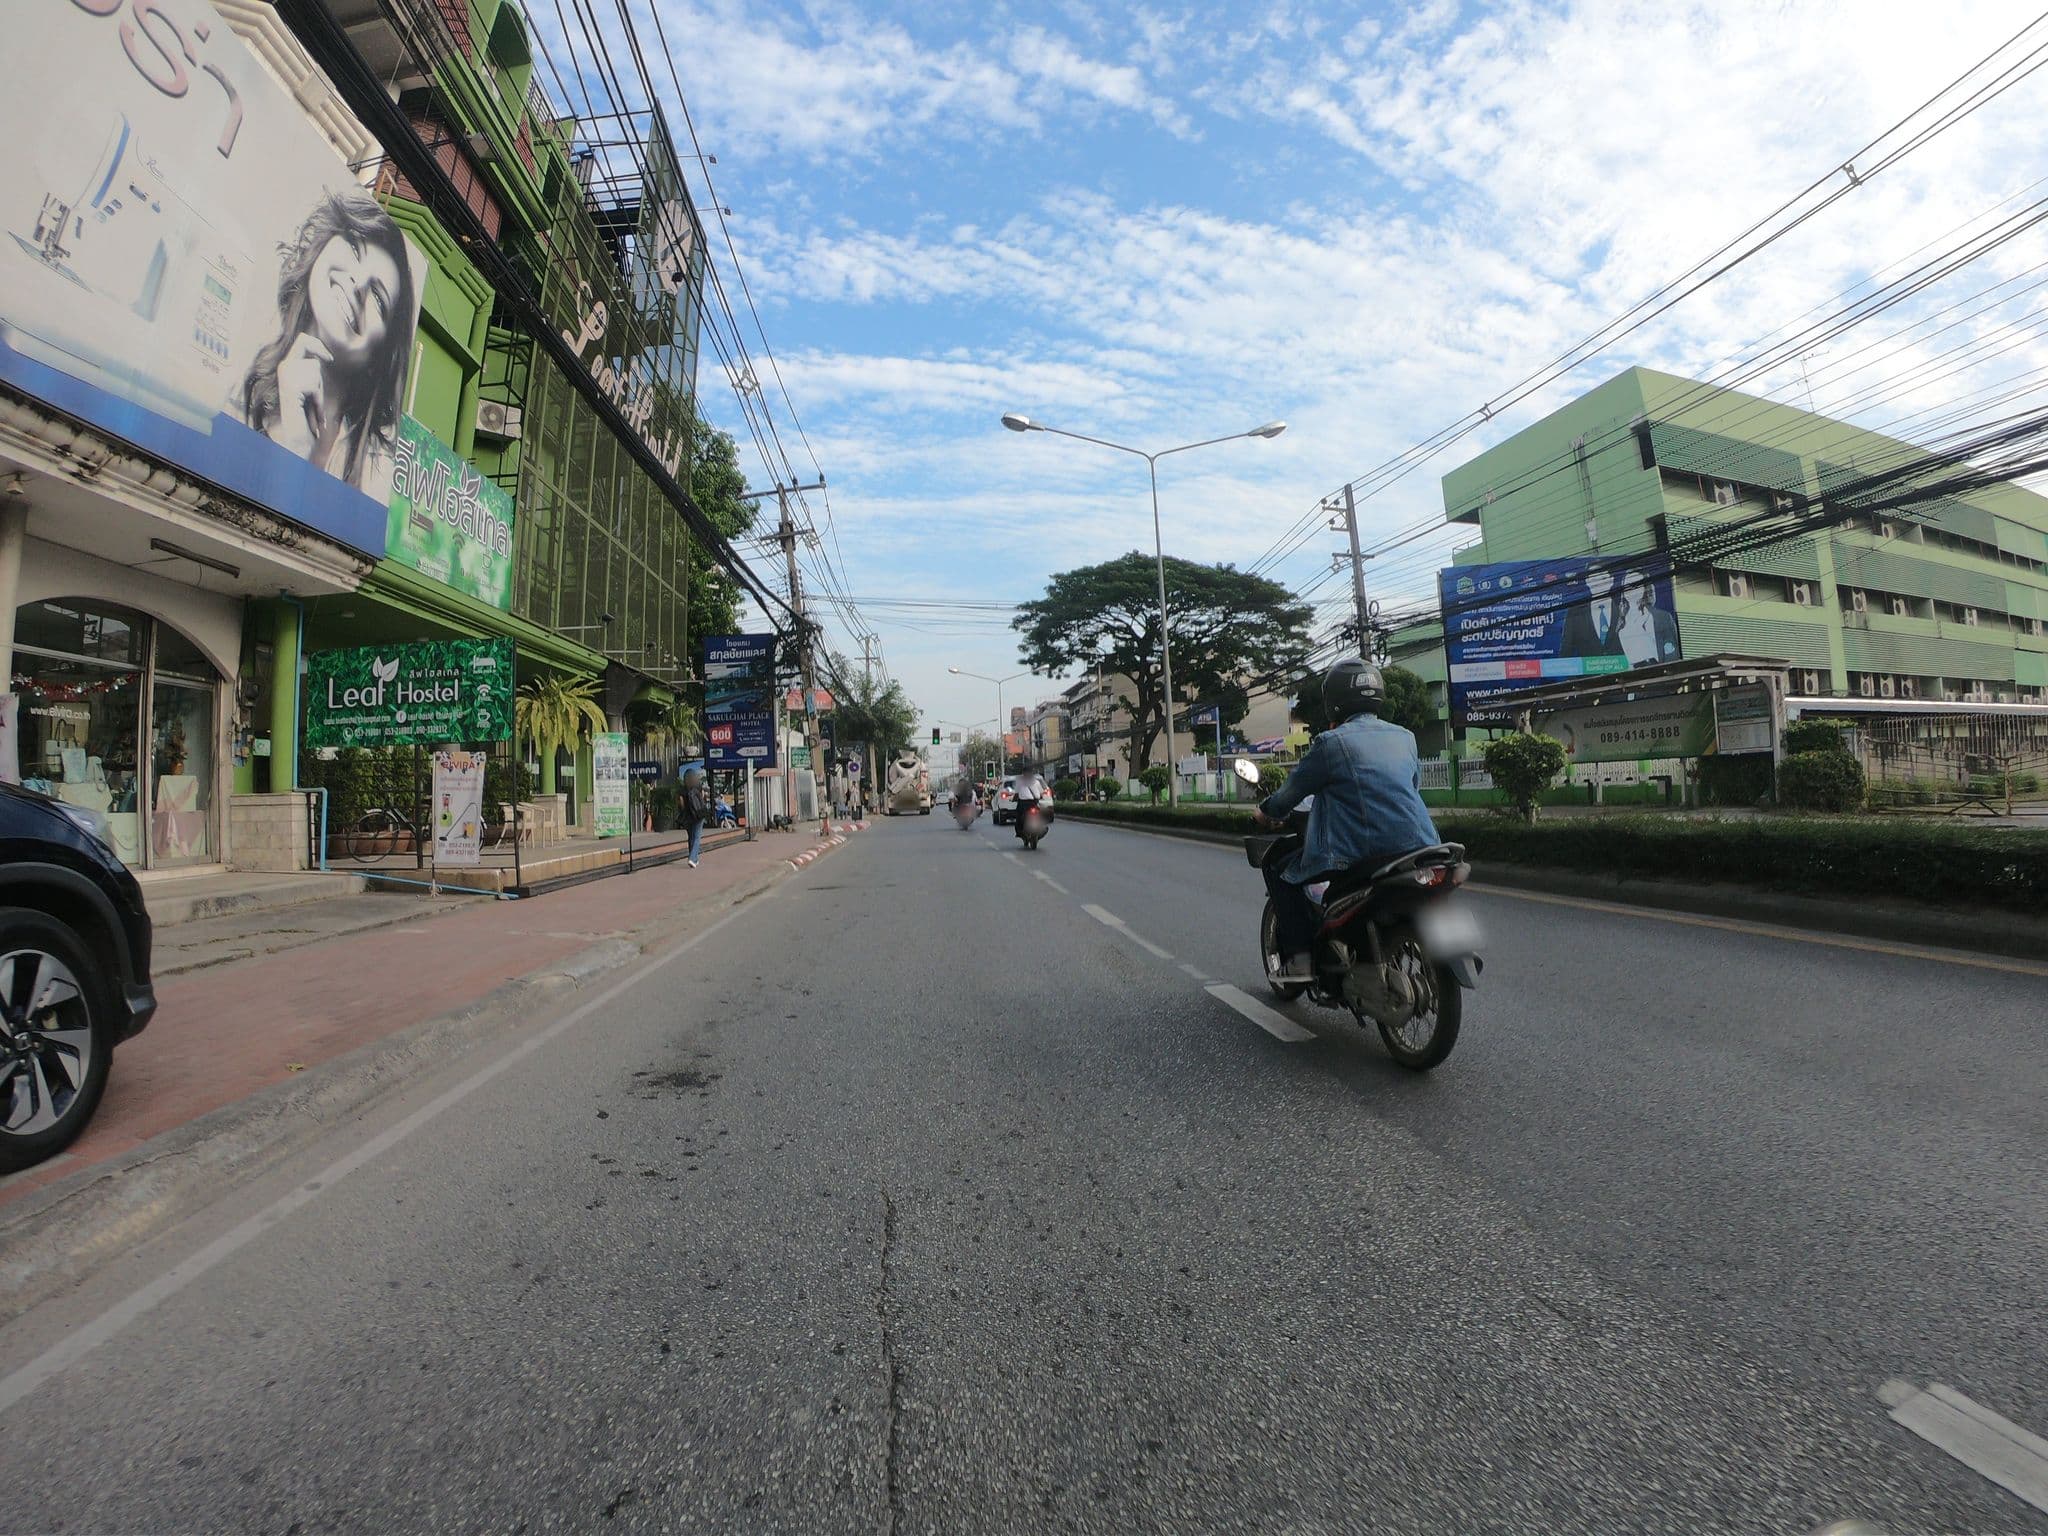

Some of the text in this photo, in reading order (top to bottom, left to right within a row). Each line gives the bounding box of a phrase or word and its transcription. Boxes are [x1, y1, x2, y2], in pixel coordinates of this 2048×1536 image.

[328, 677, 459, 709] Leaf Hostel
[748, 711, 769, 720] PLACE
[711, 730, 731, 741] 600
[1600, 726, 1680, 743] 089-414-8888
